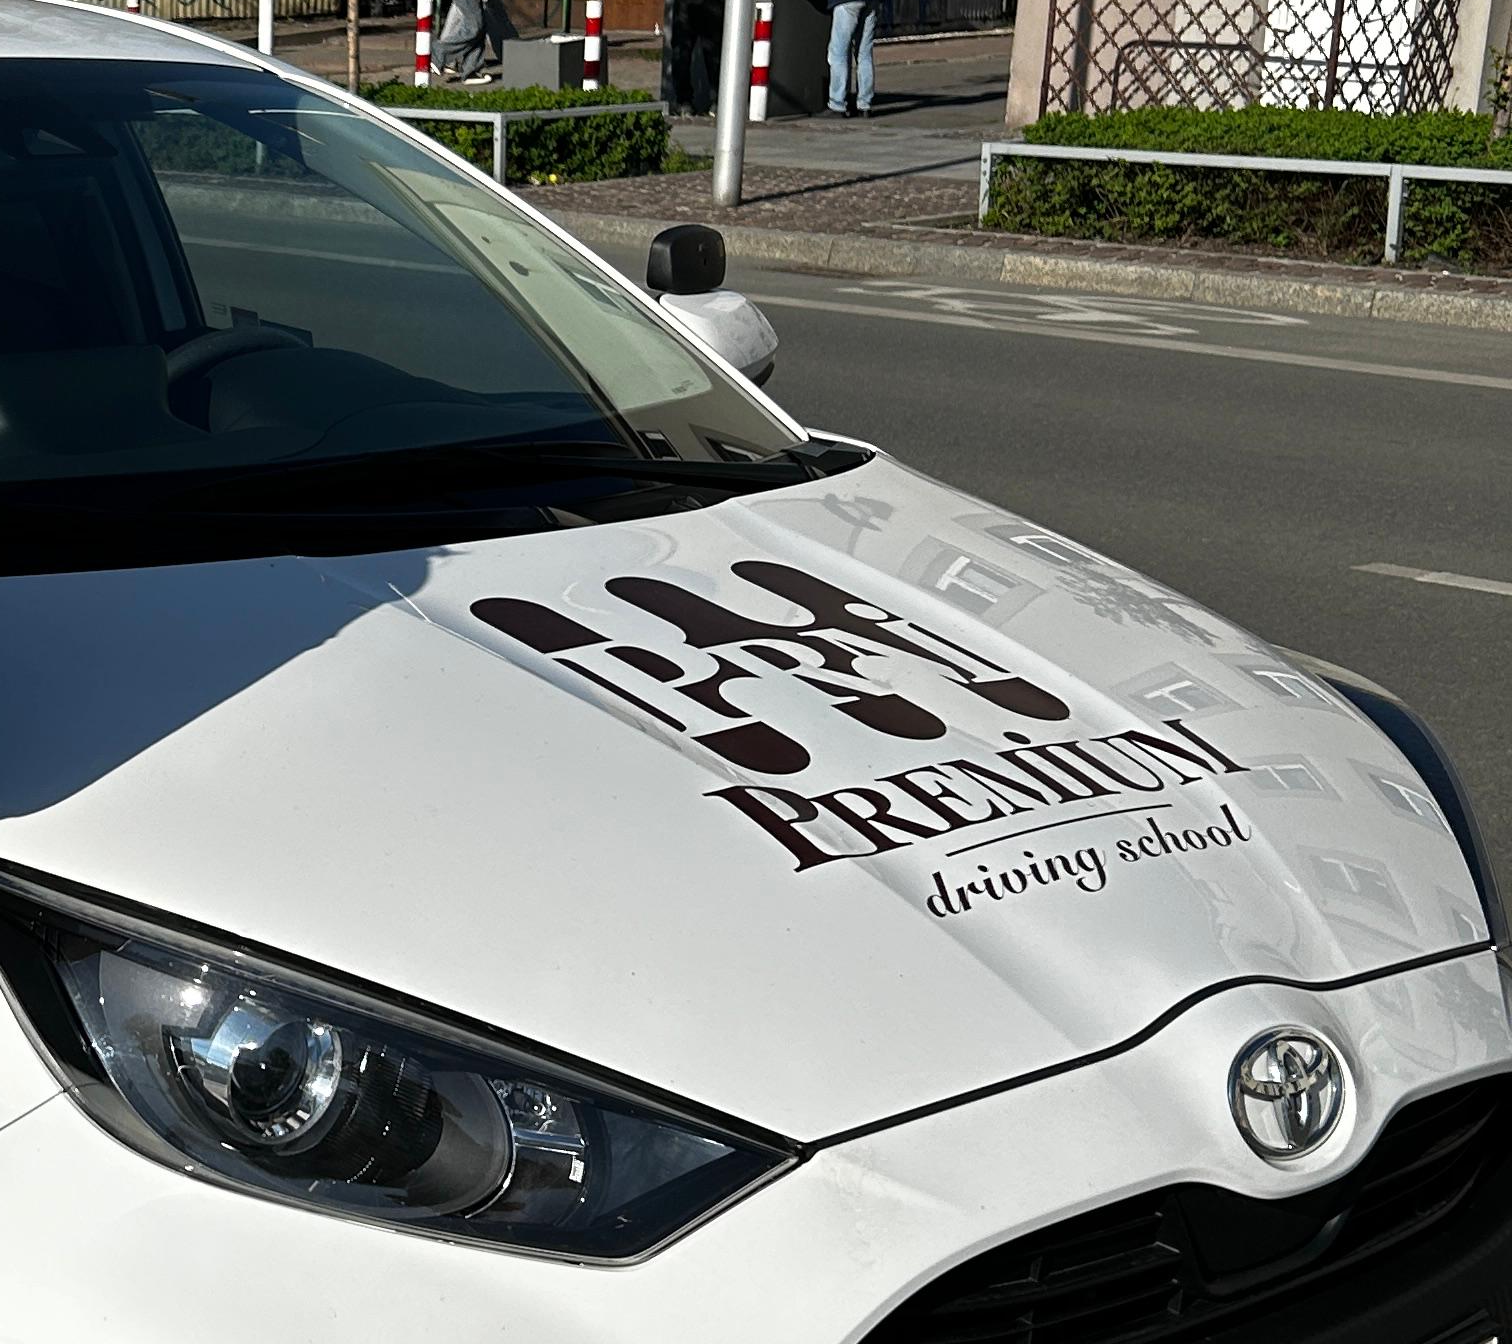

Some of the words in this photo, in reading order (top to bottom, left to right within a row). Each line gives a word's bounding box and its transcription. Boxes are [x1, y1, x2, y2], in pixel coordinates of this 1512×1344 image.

[702, 718, 1252, 873] PREMIUM
[926, 845, 1107, 919] driving
[1115, 804, 1253, 863] school
